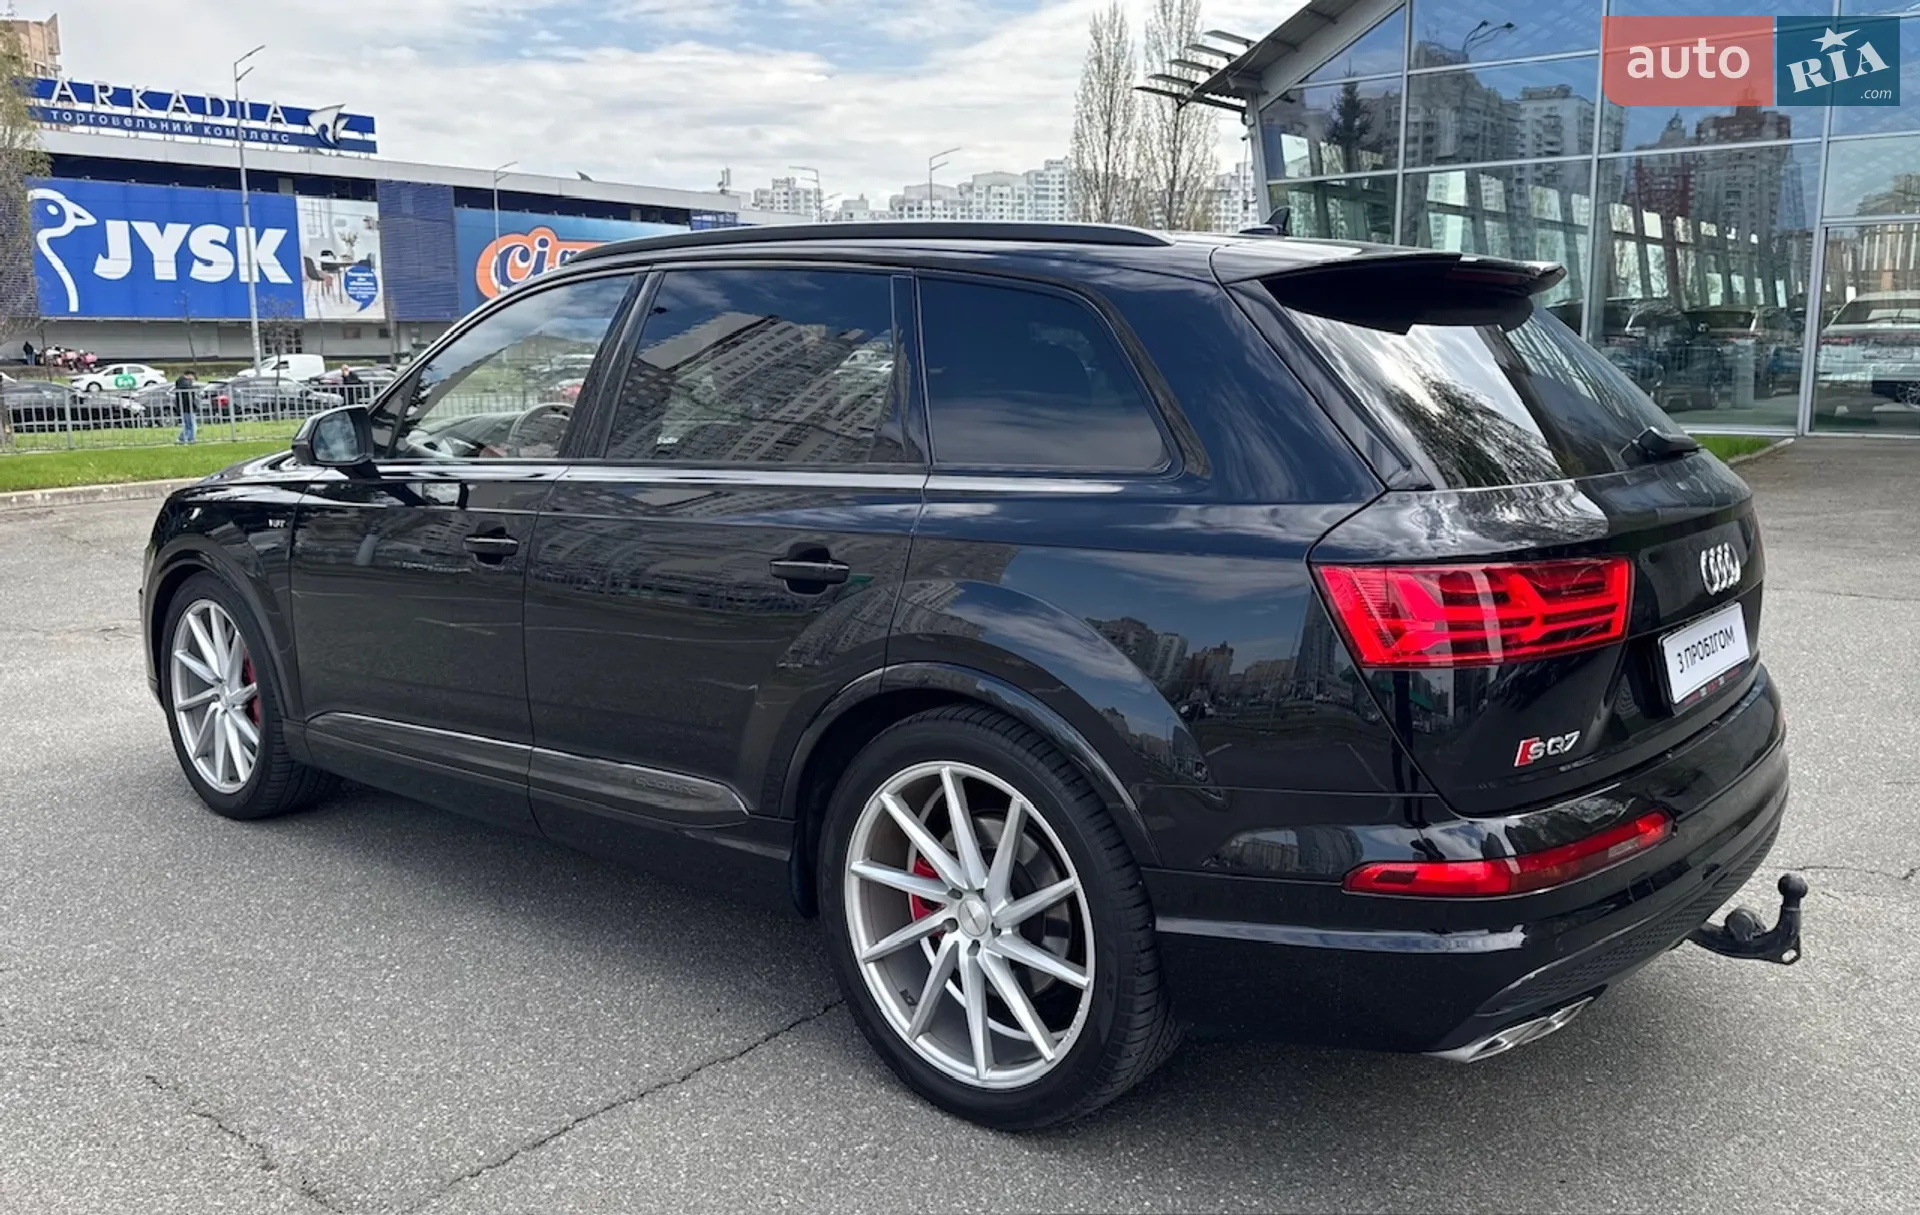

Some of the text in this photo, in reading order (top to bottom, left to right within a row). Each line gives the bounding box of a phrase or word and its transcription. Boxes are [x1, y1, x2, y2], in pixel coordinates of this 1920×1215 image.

[50, 76, 289, 128] ARKADIA
[50, 109, 194, 134] торговельний
[93, 219, 293, 284] JYSK
[1684, 625, 1736, 669] ПРОБІГОМ
[1526, 730, 1581, 762] SQ7
